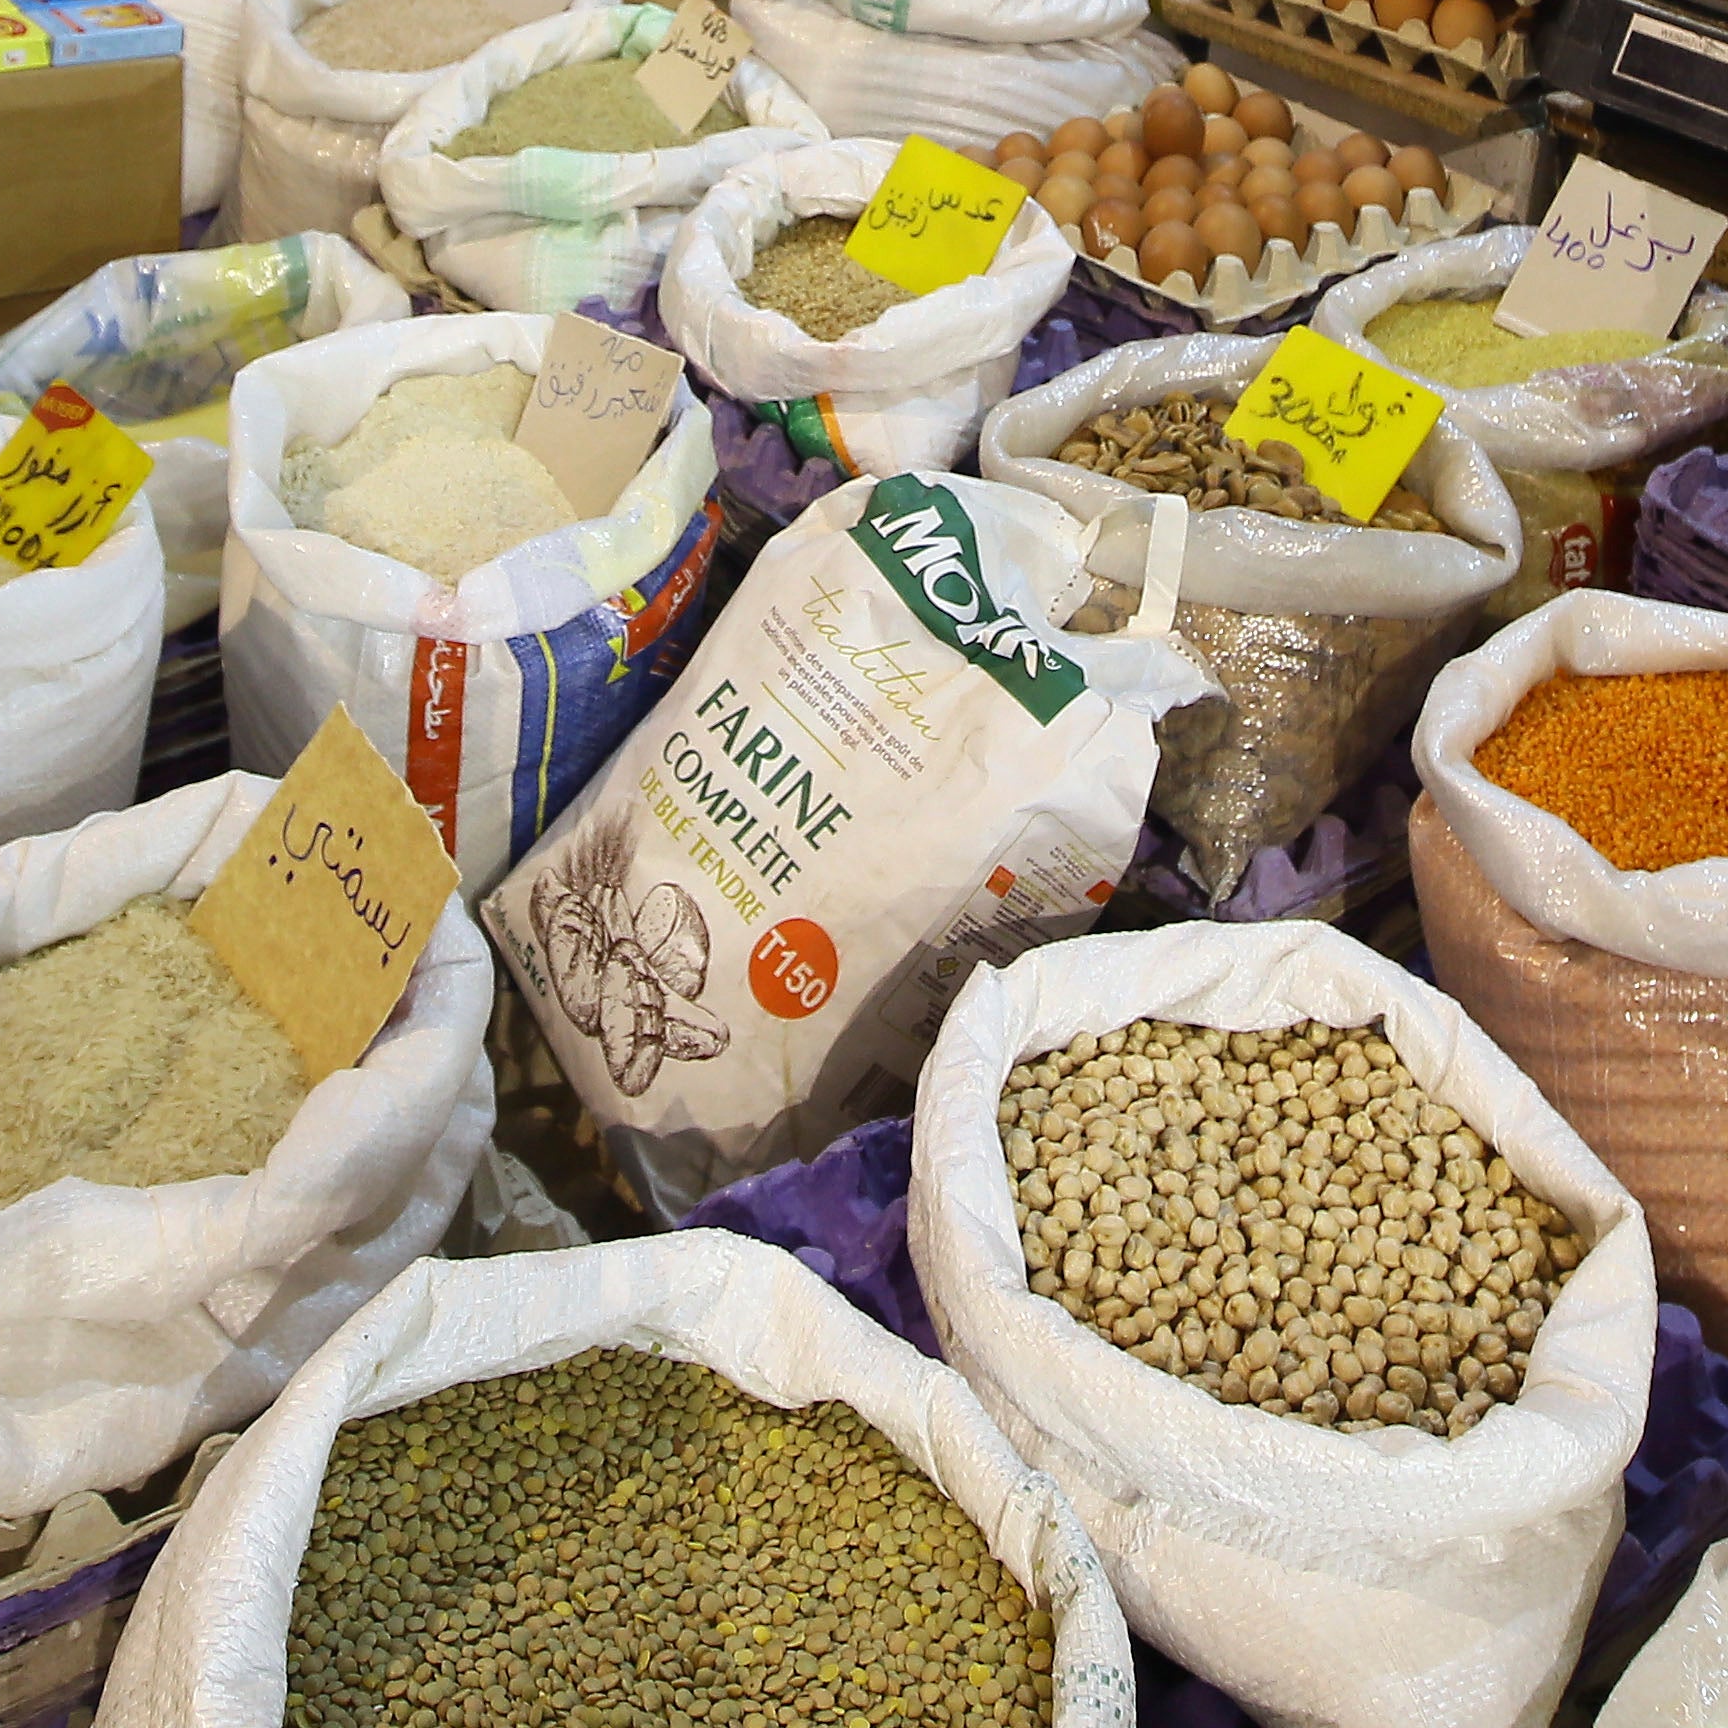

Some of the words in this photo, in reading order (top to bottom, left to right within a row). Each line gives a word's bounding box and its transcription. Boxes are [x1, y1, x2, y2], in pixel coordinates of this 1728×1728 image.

[1546, 214, 1606, 271] 400
[1589, 191, 1696, 272] برغل
[778, 669, 790, 681] un
[788, 679, 819, 710] plaisir
[819, 709, 840, 730] sans
[801, 576, 942, 742] tradition
[806, 650, 825, 671] des
[877, 723, 889, 736] au
[886, 734, 911, 760] goût
[909, 755, 925, 772] des
[695, 678, 852, 854] FARINE
[832, 702, 856, 727] pour
[873, 742, 911, 782] procurer
[639, 766, 663, 801] DE
[653, 794, 697, 842] BLÉ
[688, 832, 766, 927] TENDRE
[660, 730, 802, 898] COMPLÈTE
[268, 803, 412, 968] بسمتي
[754, 929, 830, 1012] T150
